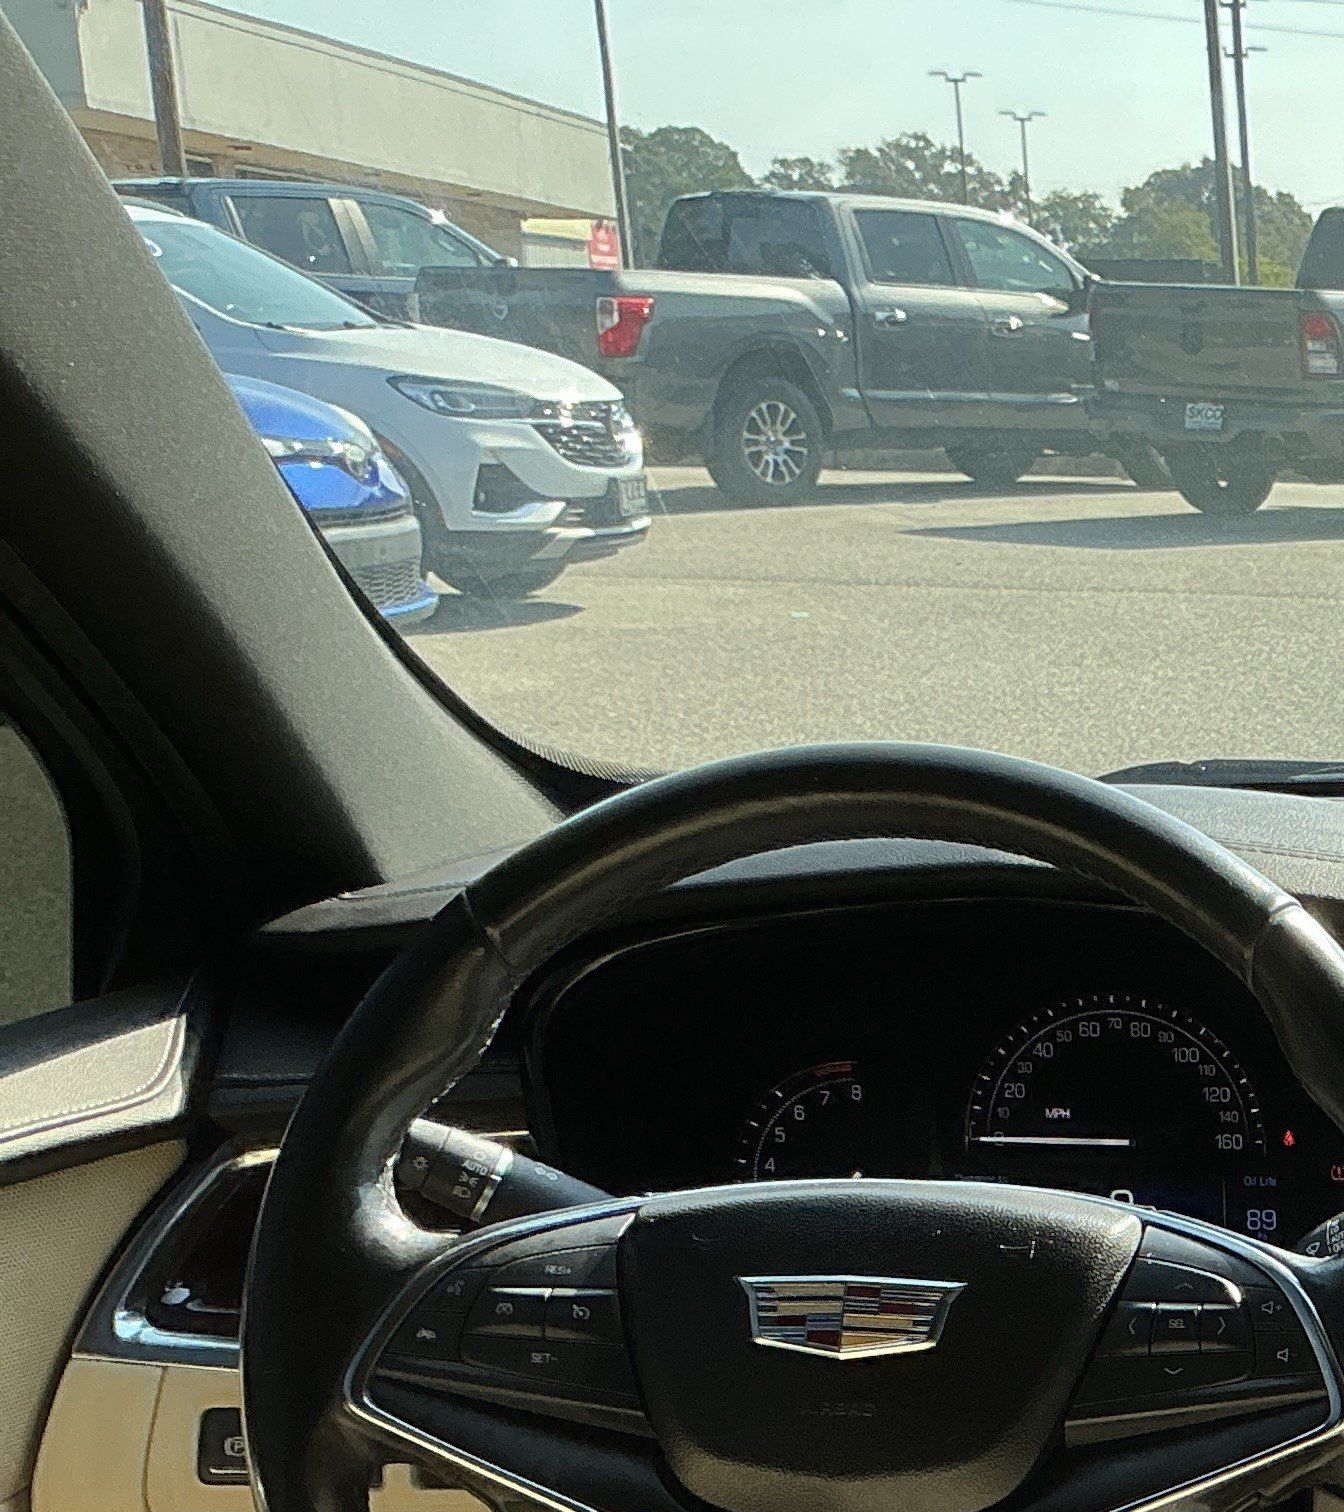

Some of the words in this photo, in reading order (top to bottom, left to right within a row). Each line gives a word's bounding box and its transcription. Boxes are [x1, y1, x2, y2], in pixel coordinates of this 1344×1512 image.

[1079, 1021, 1100, 1037] 60
[1108, 1018, 1122, 1029] 70
[1130, 1022, 1151, 1038] 80
[1056, 1030, 1072, 1042] 50
[1158, 1031, 1174, 1043] 90
[1033, 1042, 1054, 1058] 40
[1172, 1047, 1199, 1063] 100
[1199, 1064, 1216, 1077] 110
[820, 1090, 831, 1106] 7
[851, 1084, 862, 1101] 8
[1004, 1083, 1026, 1098] 20
[1203, 1086, 1231, 1102] 120
[793, 1104, 806, 1121] 6
[1045, 1108, 1071, 1119] MPH
[1219, 1111, 1239, 1123] 140
[774, 1126, 786, 1143] 5
[1214, 1133, 1243, 1150] 160
[460, 1157, 490, 1177] AUTO
[764, 1157, 776, 1173] 4
[1246, 1208, 1277, 1231] 89
[1168, 1318, 1187, 1329] SEL
